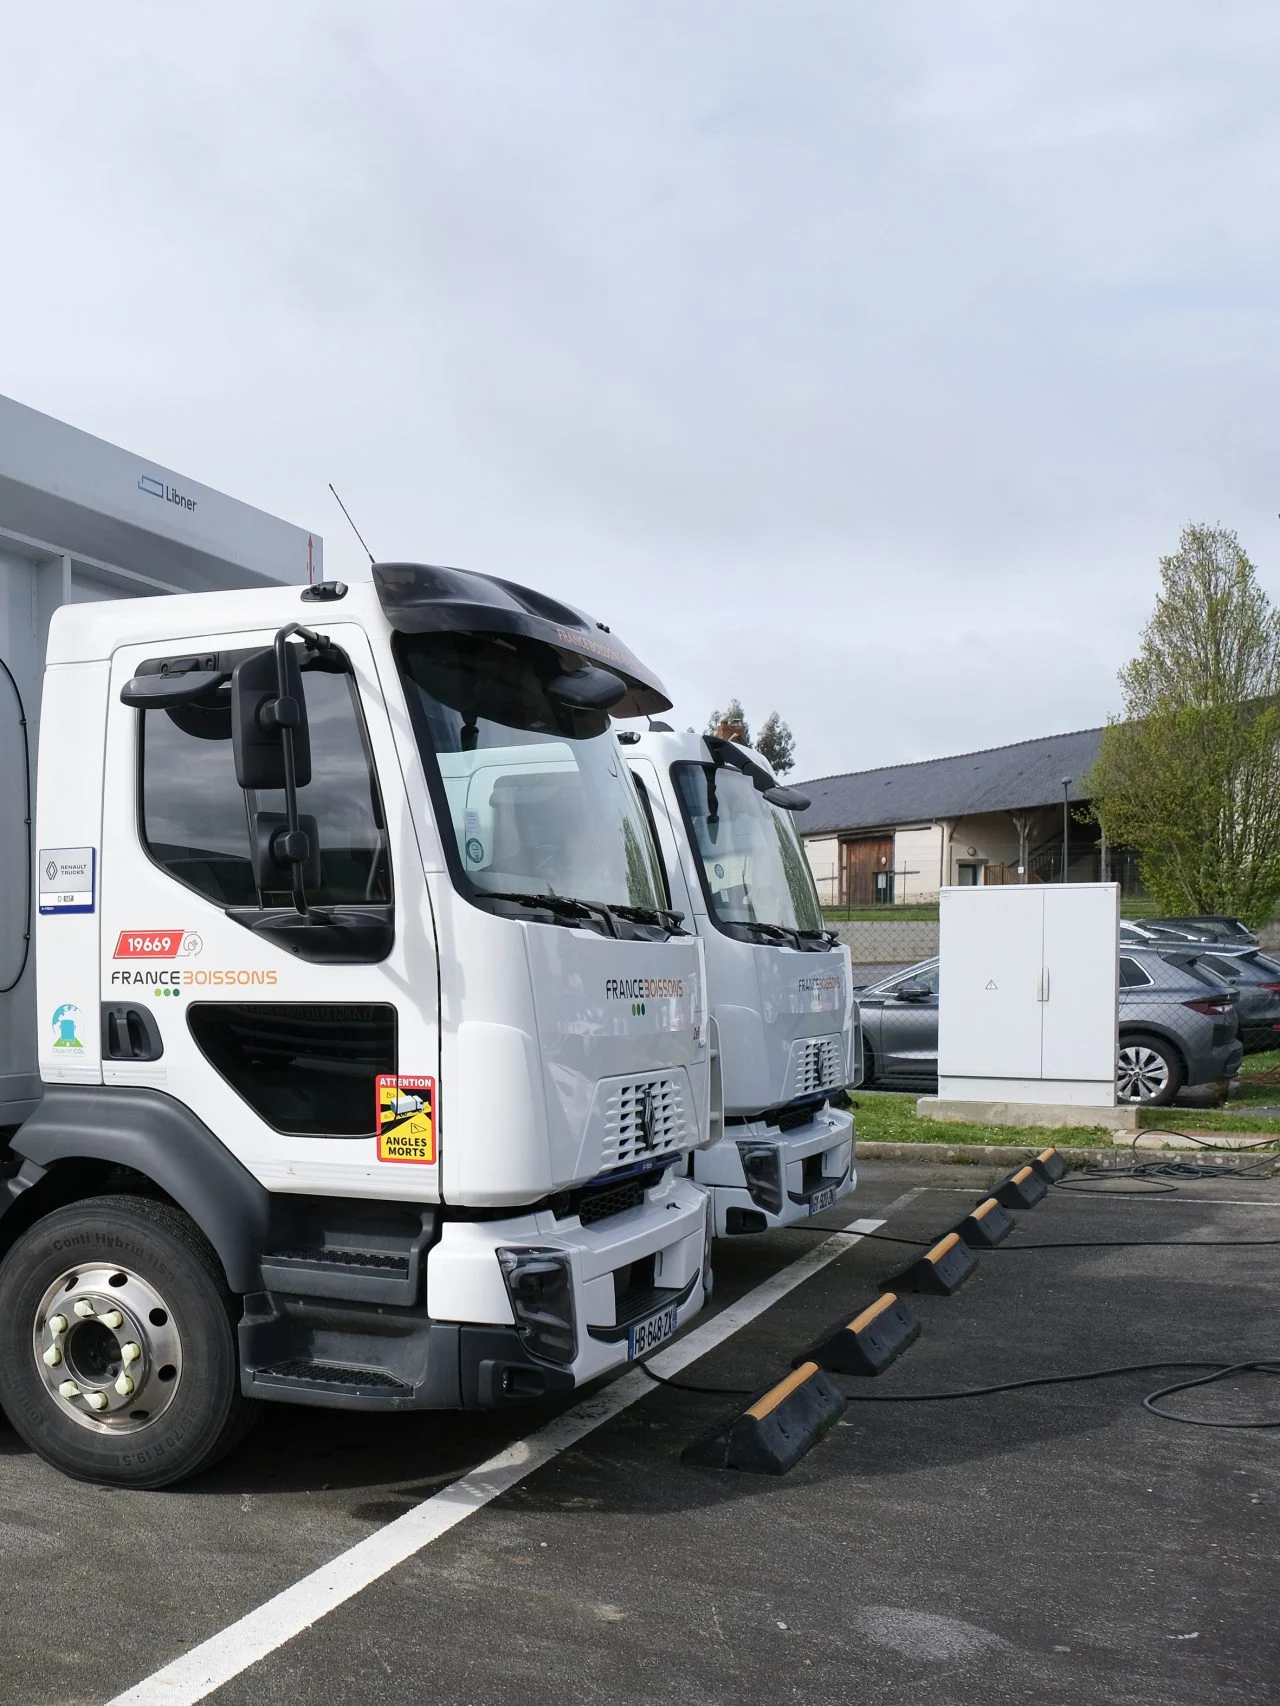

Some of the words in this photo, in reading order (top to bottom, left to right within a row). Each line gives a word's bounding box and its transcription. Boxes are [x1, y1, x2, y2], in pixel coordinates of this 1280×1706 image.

[165, 484, 198, 512] Libner
[127, 937, 171, 952] 19669
[379, 1077, 433, 1088] ATTENTION
[385, 1136, 428, 1148] ANGLES
[387, 1147, 426, 1158] MORTS
[53, 1232, 91, 1252] Conti
